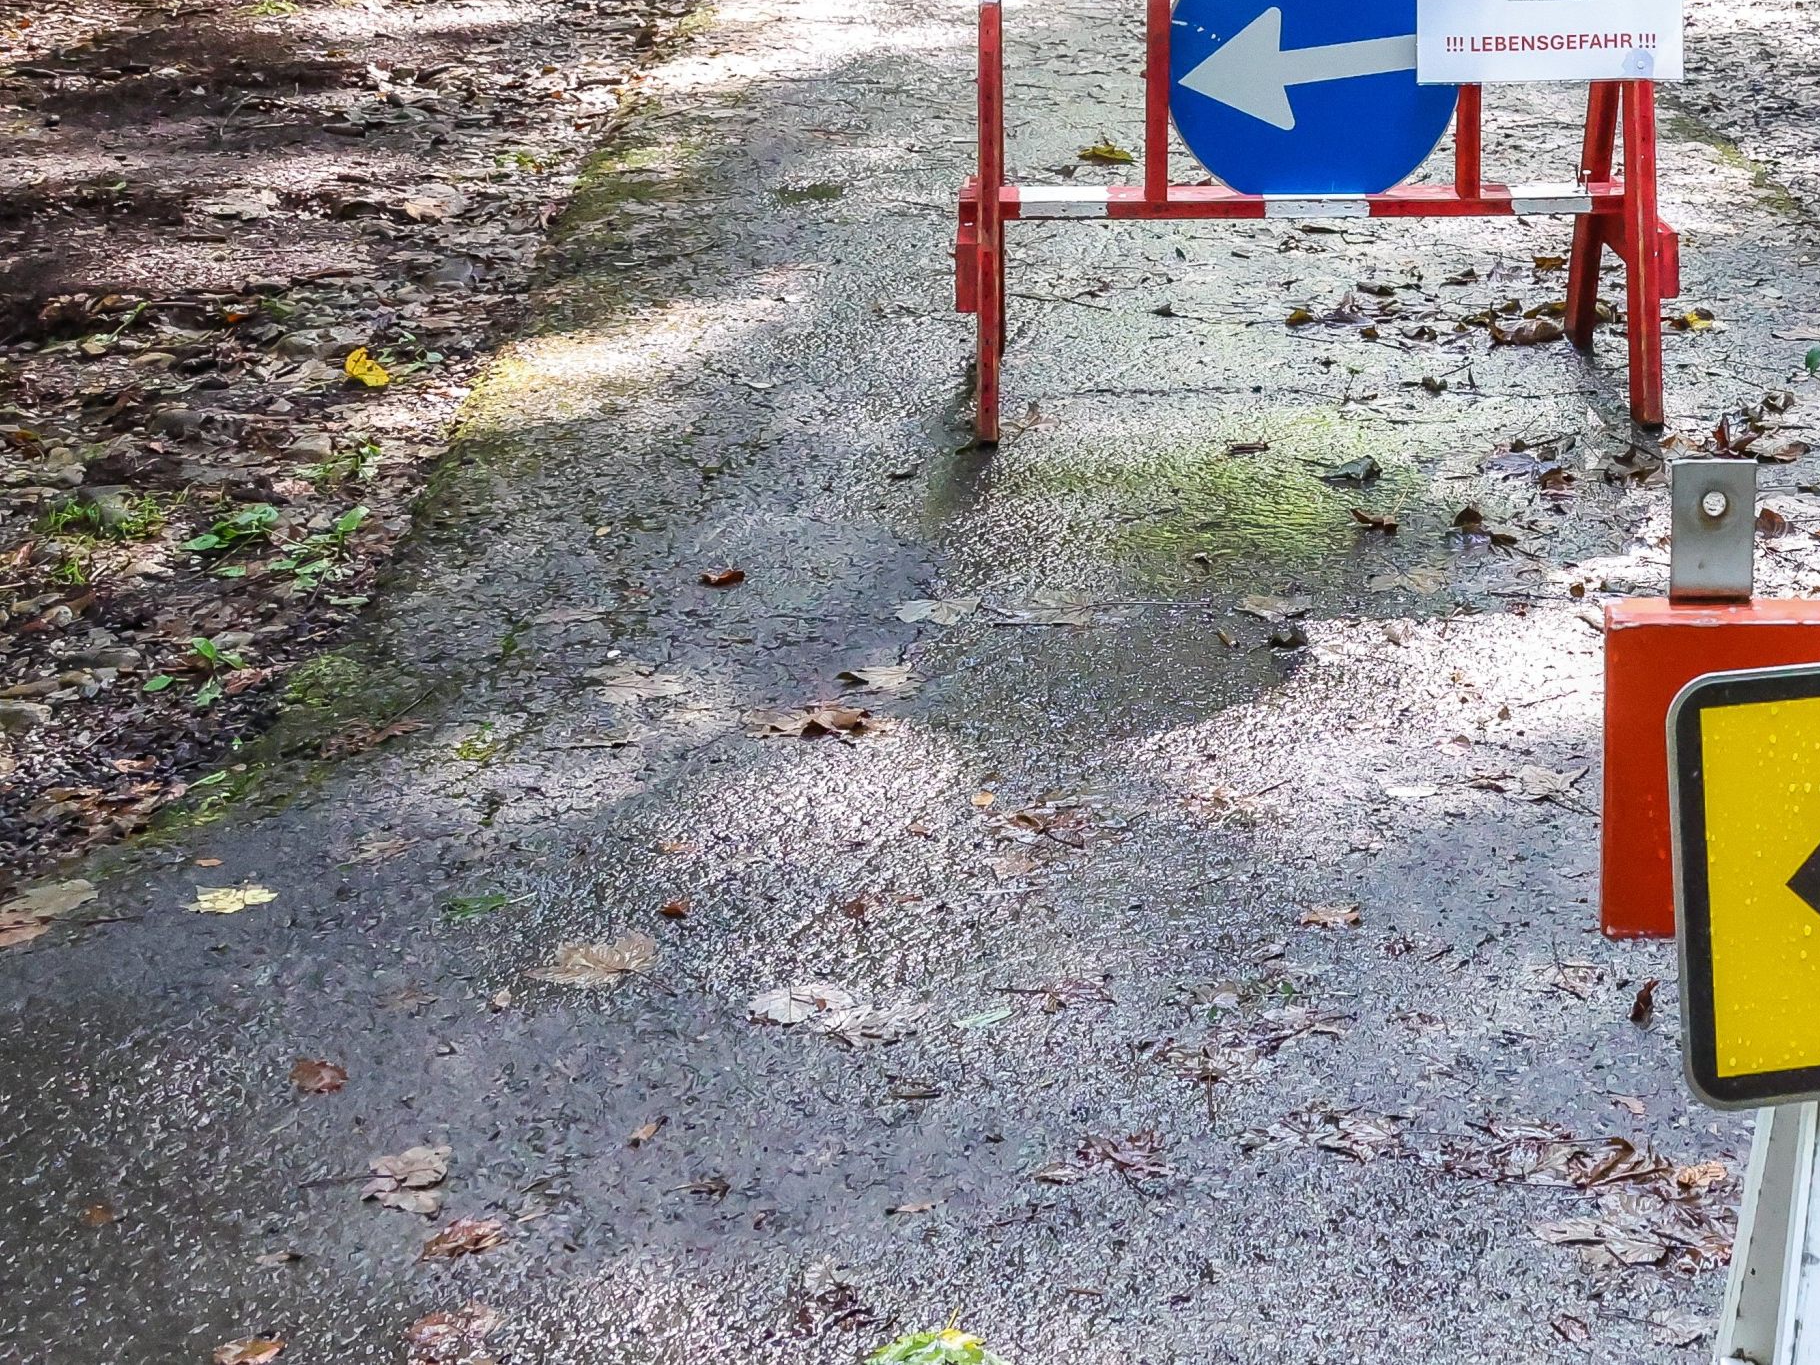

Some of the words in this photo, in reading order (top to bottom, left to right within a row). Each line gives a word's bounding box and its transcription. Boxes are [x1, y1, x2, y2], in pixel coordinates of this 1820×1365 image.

[1446, 36, 1464, 52] !!!
[1470, 33, 1633, 52] LEBENSGEFAHR
[1638, 33, 1656, 49] !!!
